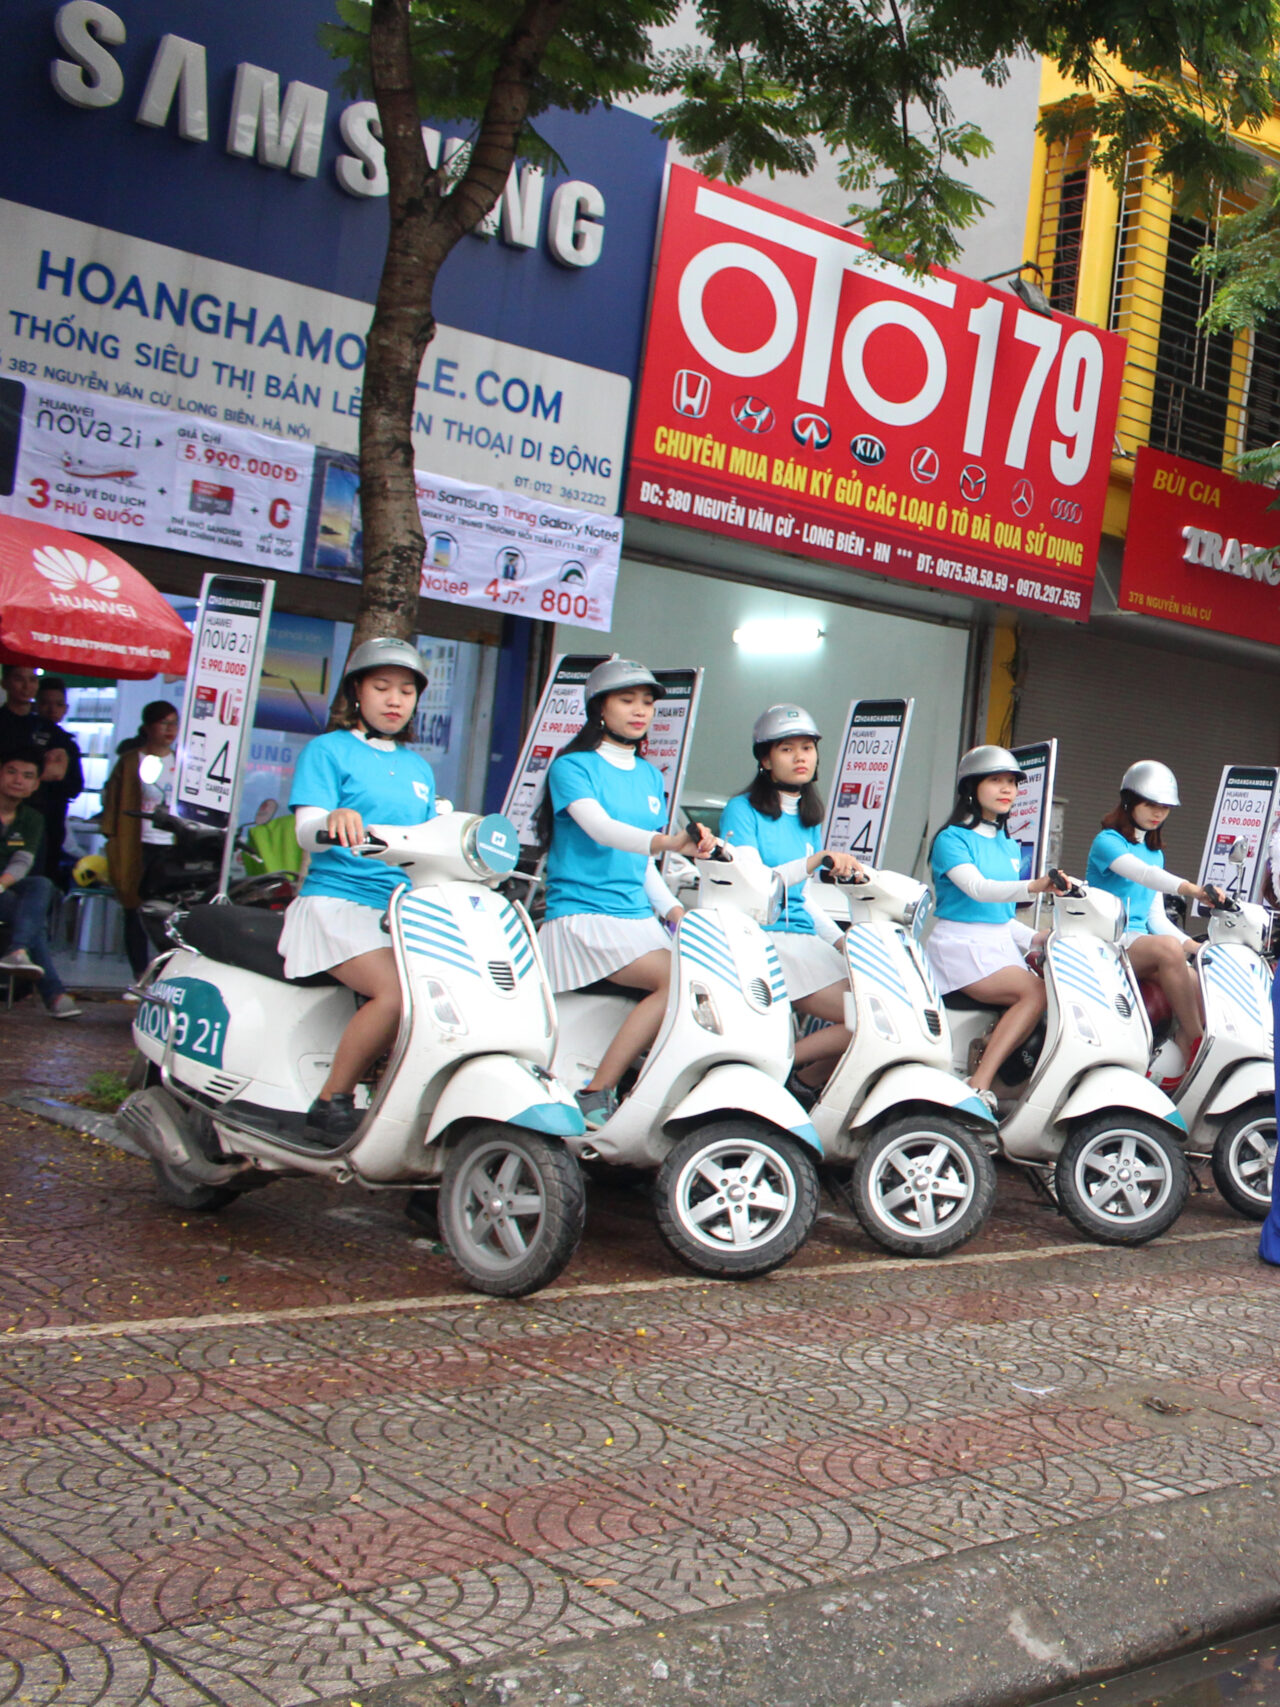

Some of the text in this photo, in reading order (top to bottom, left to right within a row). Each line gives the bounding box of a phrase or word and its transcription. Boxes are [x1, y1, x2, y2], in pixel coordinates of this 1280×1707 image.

[8, 358, 37, 375] 382
[44, 366, 108, 392] NGUYỄN
[115, 382, 143, 399] VĂN
[178, 398, 217, 417] LONG
[263, 415, 282, 432] HÀ
[287, 421, 310, 439] NỘI
[9, 309, 120, 360] THỐNG
[135, 344, 199, 378] SIÊU
[212, 361, 255, 399] THỊ
[265, 372, 321, 408] BÁN
[443, 418, 513, 458] THOẠI
[521, 438, 542, 461] DI
[550, 445, 612, 478] ĐỘNG
[39, 398, 94, 417] HUAWEI
[963, 297, 1103, 486] 179
[37, 409, 142, 449] nova 2i
[28, 478, 50, 509] 3
[654, 425, 1084, 567] CHUYÊN MUA BÁN KÝ GỬI CÁC LOẠI Ô TÔ ĐÃ QUA SỬ DỤNG
[1152, 468, 1221, 508] BÙI GIA
[54, 500, 145, 526] PHÚ QUỐC
[438, 490, 620, 543] Samsung Trúng Galaxy Note8
[641, 481, 1081, 609] ĐC: 380 NGUYỄN VĂN CỪ LONG BIÊN HN ĐT: 0975.58.58.59 0978.297.555
[49, 592, 137, 618] HUAWEI
[420, 574, 468, 596] Note8
[485, 578, 501, 603] 4
[541, 589, 588, 618] 800
[202, 628, 237, 651] nova
[240, 634, 252, 653] 2i
[546, 698, 579, 715] nova
[207, 740, 231, 784] 4
[848, 740, 894, 755] nova 2i
[1223, 799, 1253, 812] nova
[1254, 800, 1266, 813] 2i
[850, 820, 873, 854] 4
[150, 983, 186, 1005] UAWEI
[192, 1018, 222, 1055] 2i
